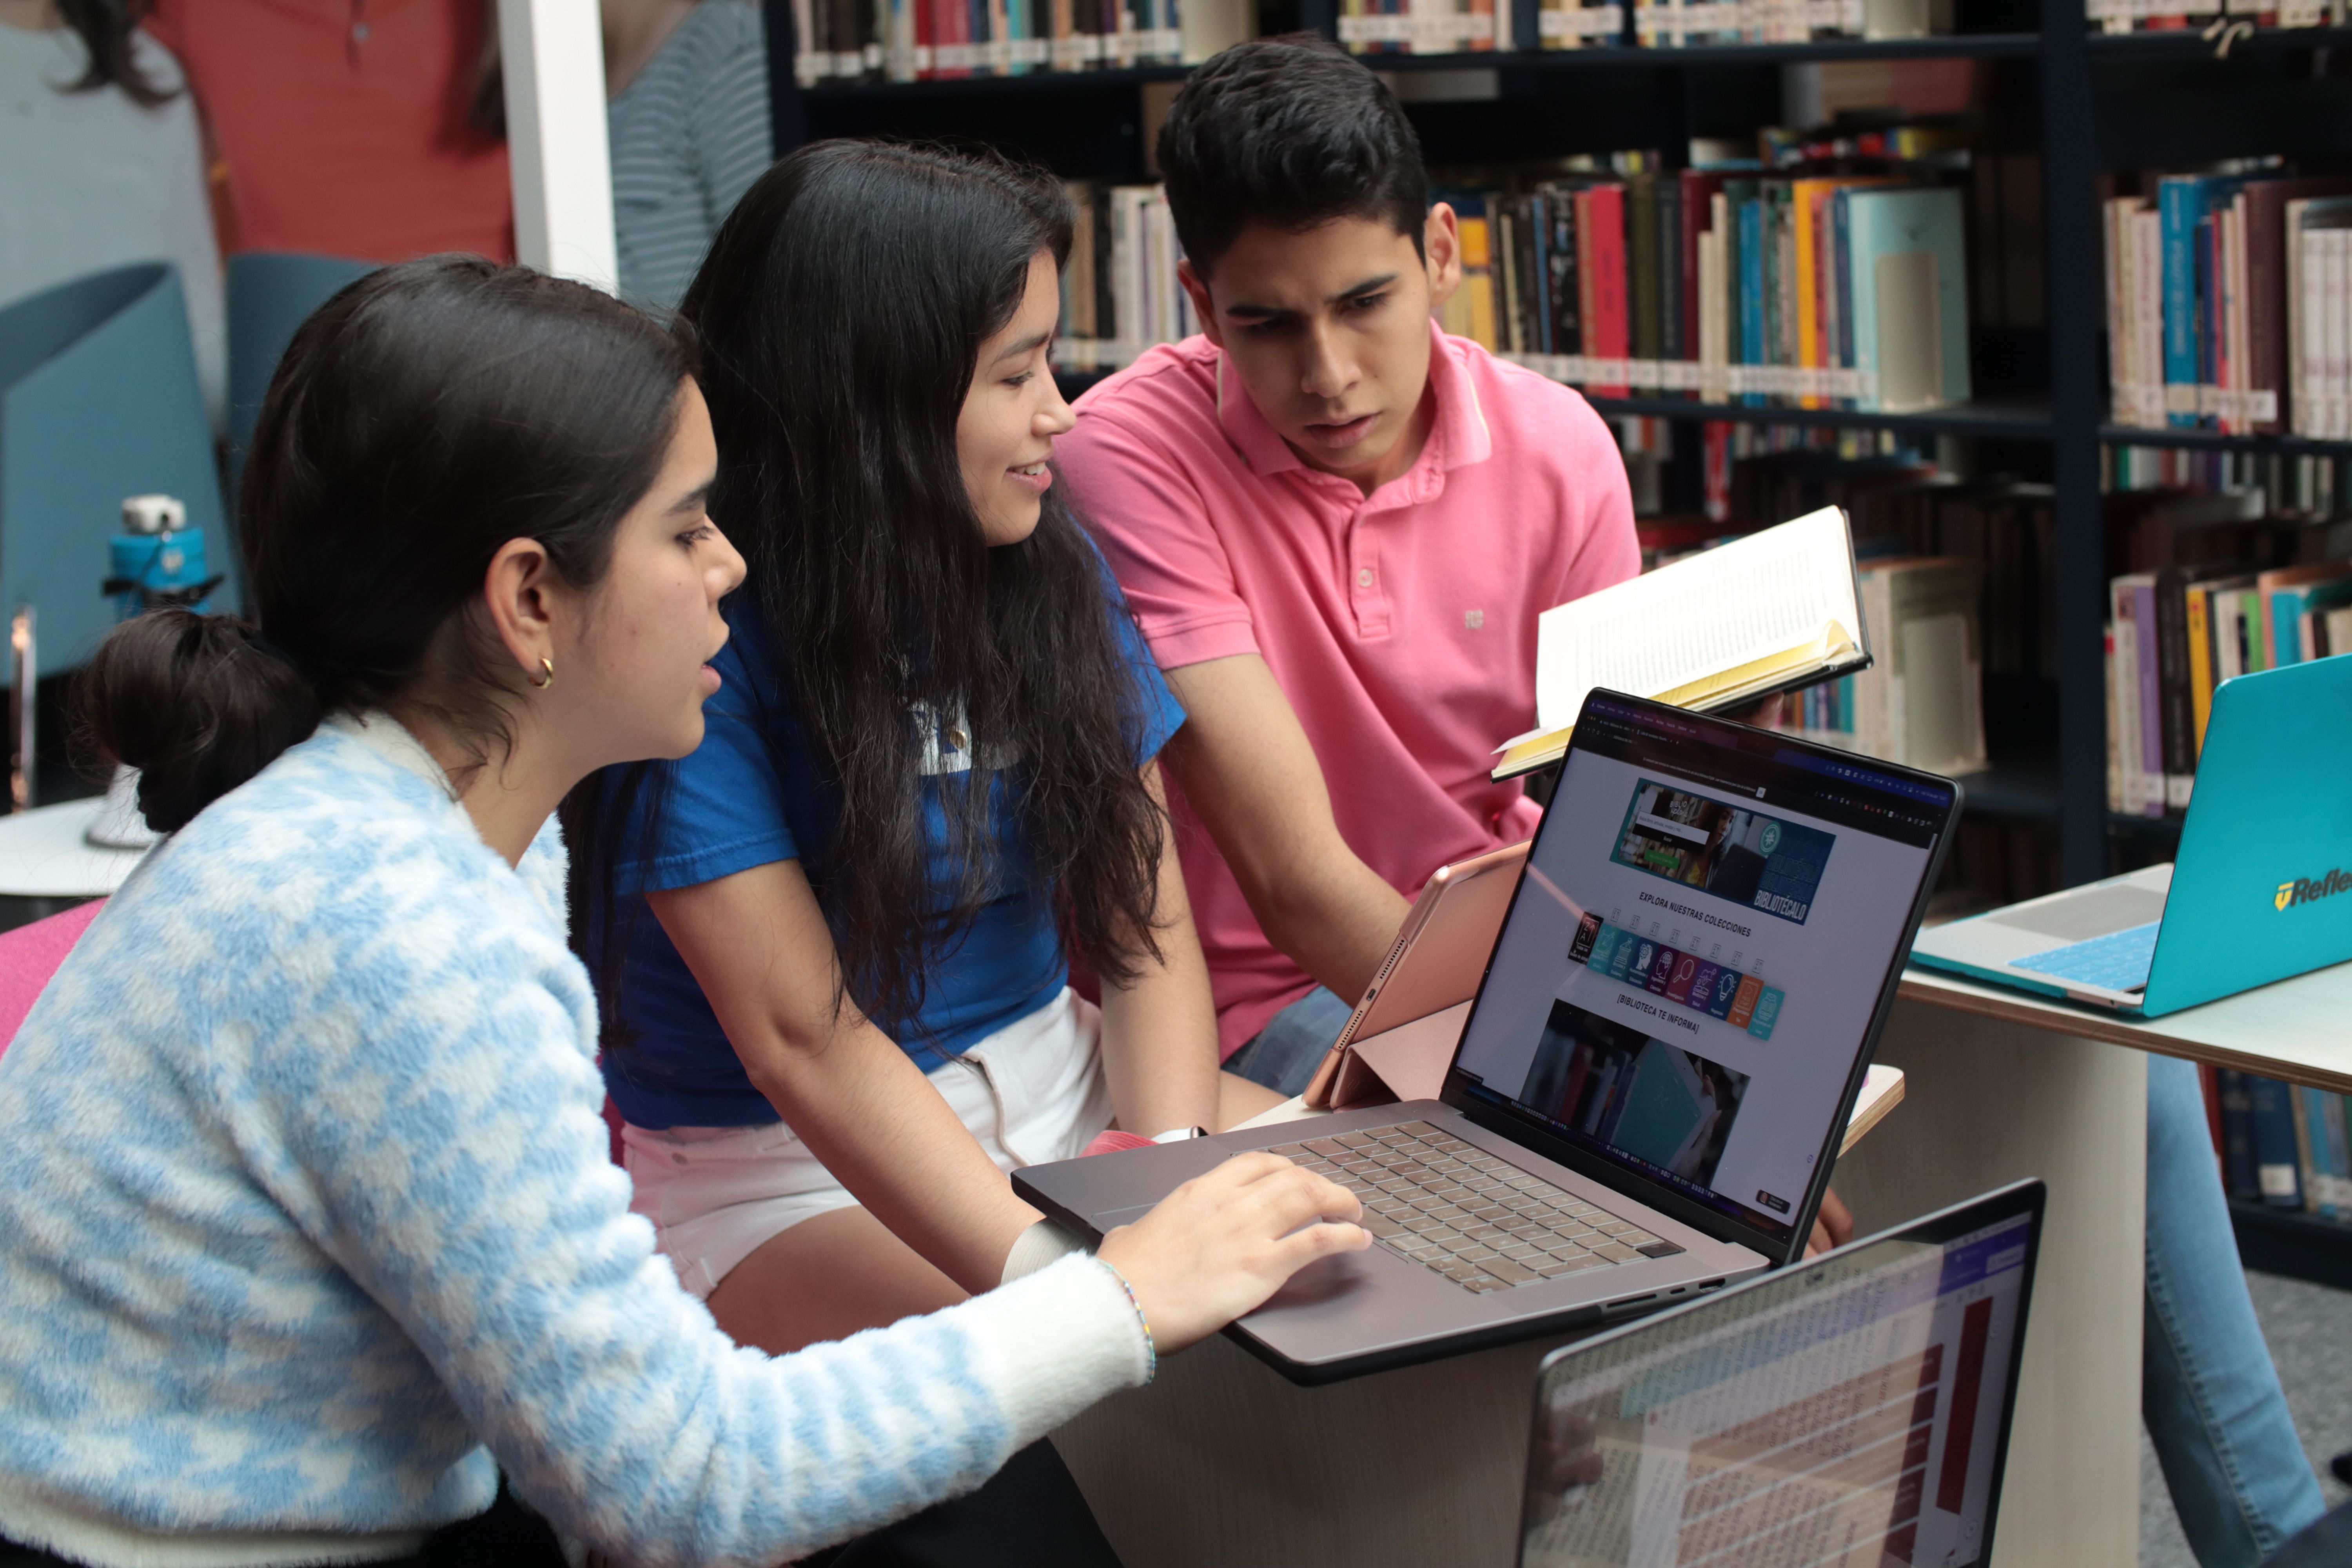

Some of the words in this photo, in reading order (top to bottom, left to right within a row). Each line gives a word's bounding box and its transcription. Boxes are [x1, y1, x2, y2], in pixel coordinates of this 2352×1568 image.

[1639, 891, 1669, 909] EXPLORA
[1669, 902, 1704, 921] NUESTRAS
[1704, 914, 1751, 937] COLECCIONES
[1754, 889, 1808, 920] BIBLIOTÉCALO
[1617, 994, 1657, 1016] [BIBLIOTECA
[1657, 1010, 1666, 1020] TE
[1666, 1013, 1700, 1034] INFORMA]
